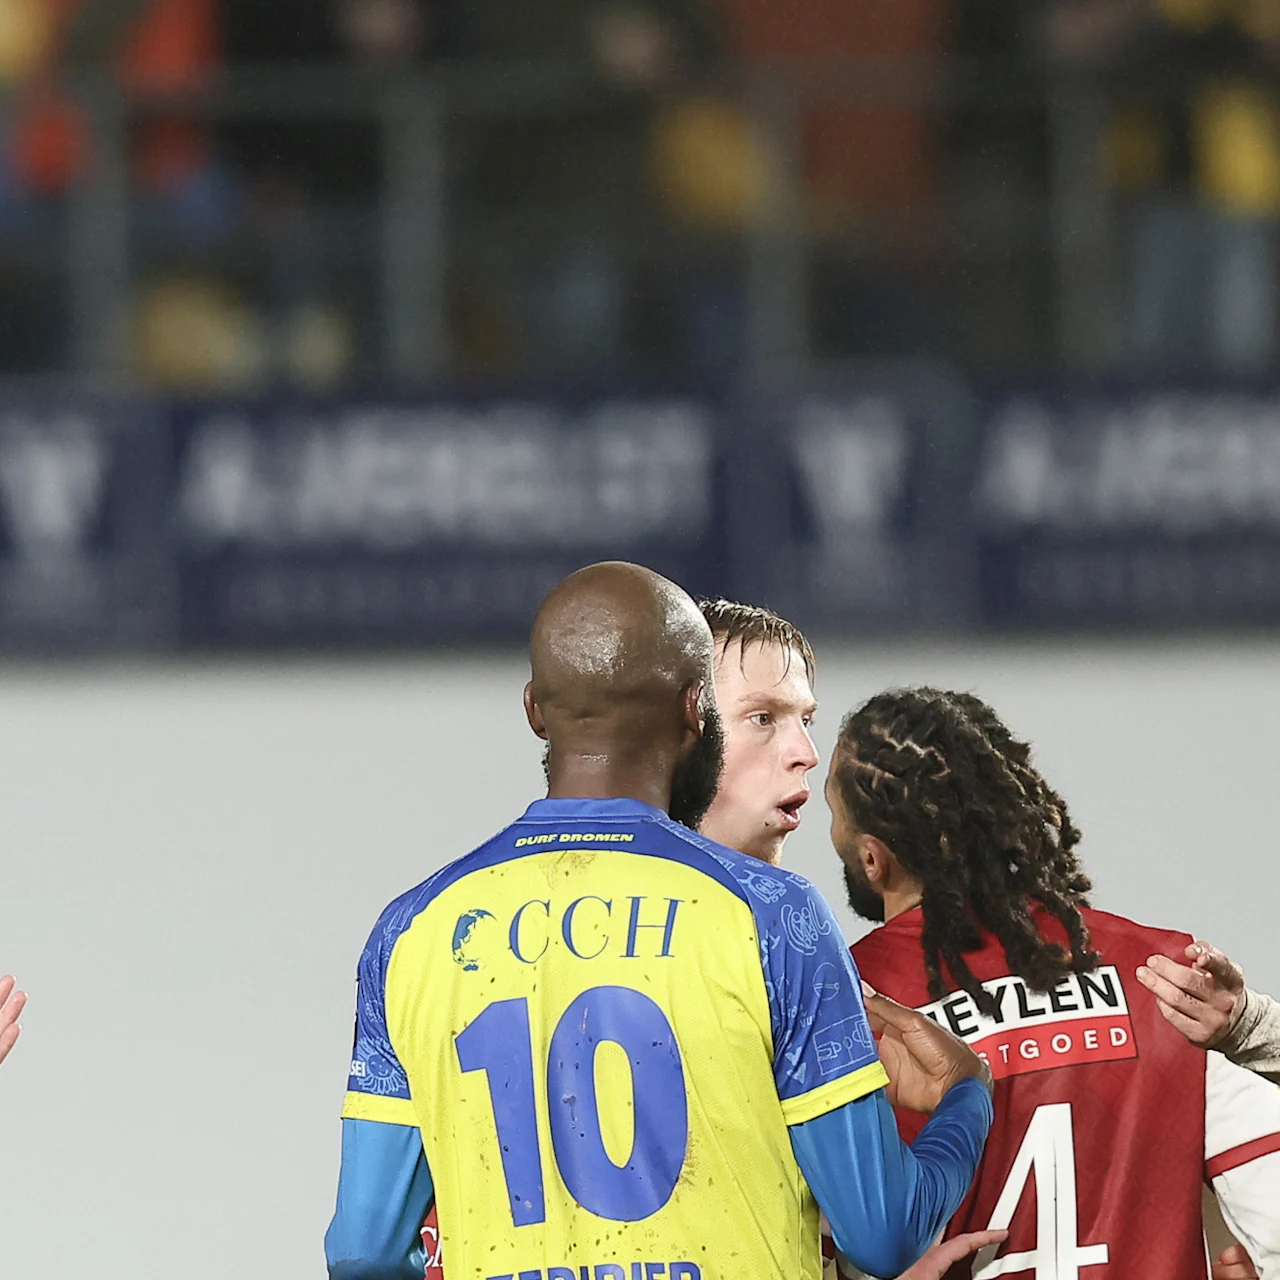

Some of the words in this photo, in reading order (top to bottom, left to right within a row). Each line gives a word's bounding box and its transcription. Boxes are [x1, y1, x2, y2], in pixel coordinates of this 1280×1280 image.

[514, 833, 558, 848] DURF
[558, 833, 635, 843] DROMEN
[350, 1060, 367, 1078] SEI
[454, 984, 689, 1228] 10
